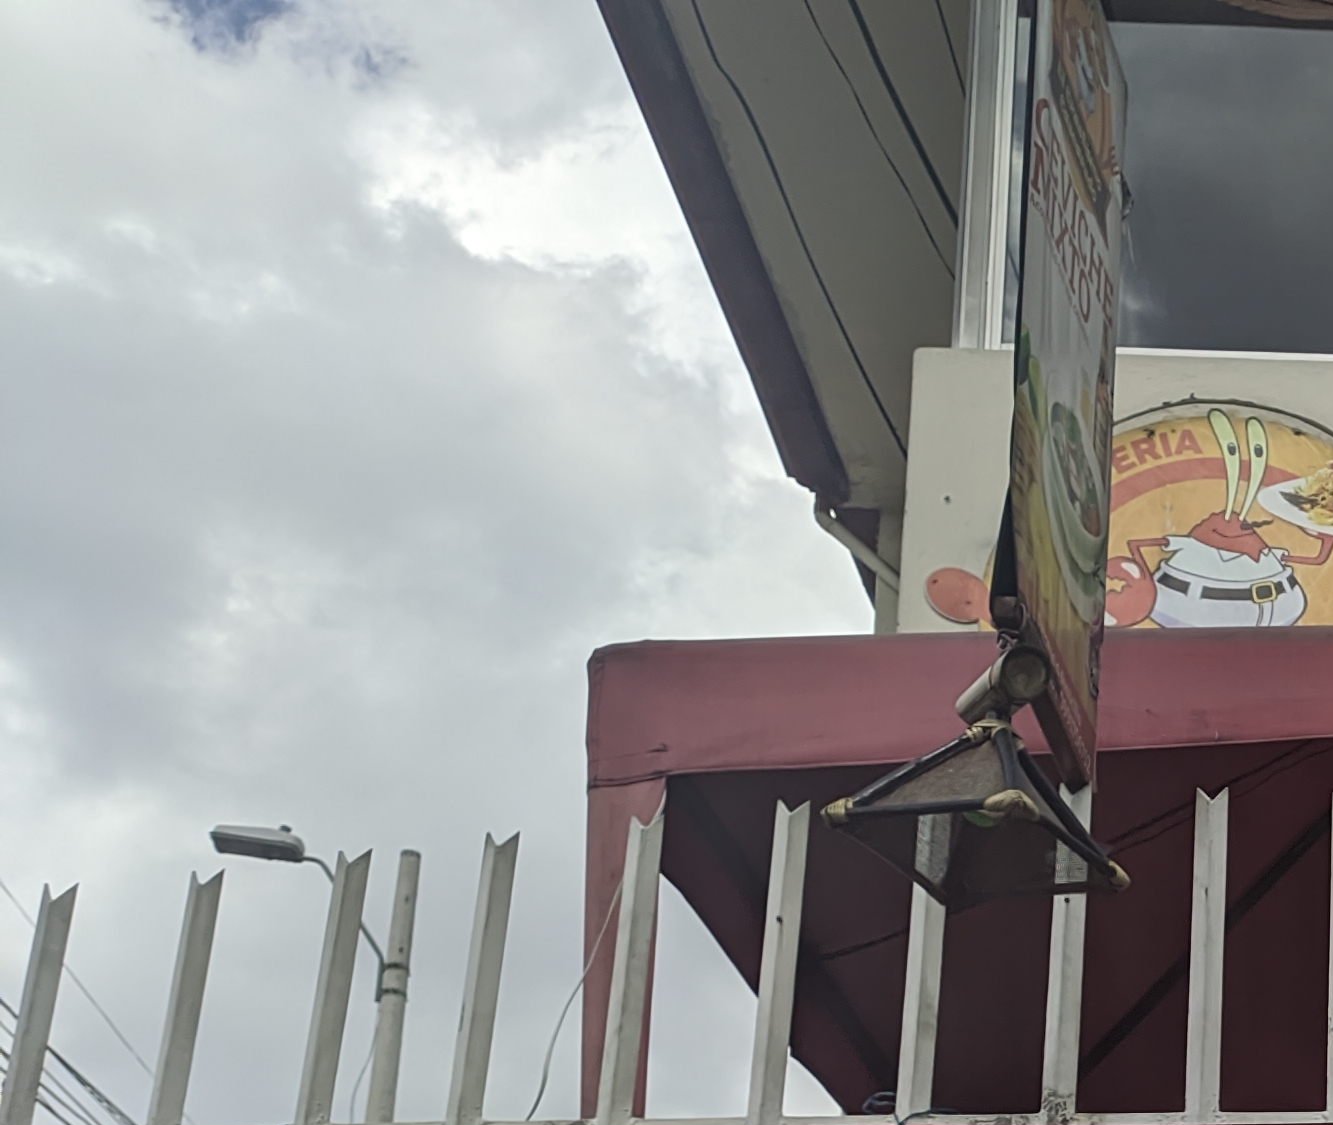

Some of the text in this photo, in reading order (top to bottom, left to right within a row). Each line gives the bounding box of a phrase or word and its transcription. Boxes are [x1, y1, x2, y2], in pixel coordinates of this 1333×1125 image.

[1031, 140, 1091, 324] MIXTO
[1035, 98, 1114, 329] CEVICHE
[1111, 429, 1203, 474] ERIA
